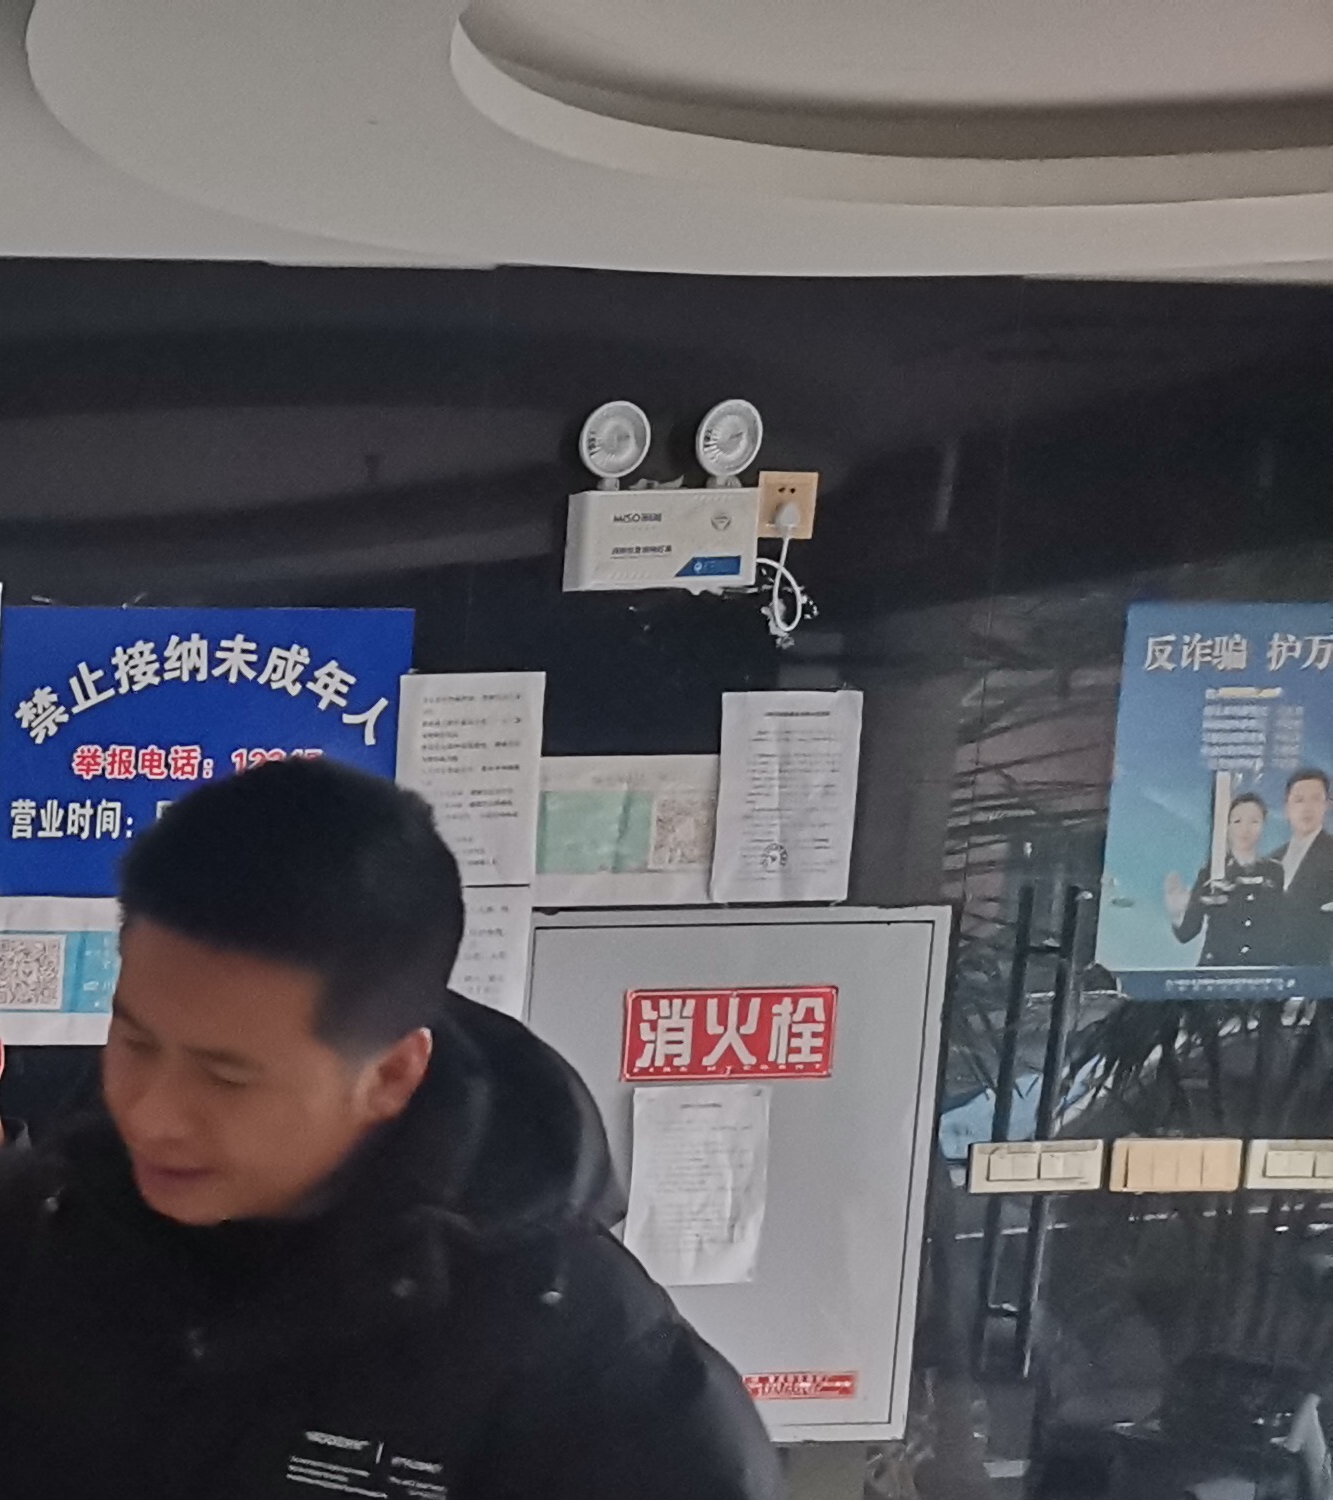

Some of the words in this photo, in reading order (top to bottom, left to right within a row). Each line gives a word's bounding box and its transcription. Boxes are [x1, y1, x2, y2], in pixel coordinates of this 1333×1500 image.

[1144, 632, 1248, 672] 反诈骗
[14, 633, 390, 746] 禁止接纳未成年人
[635, 996, 827, 1068] 消火栓
